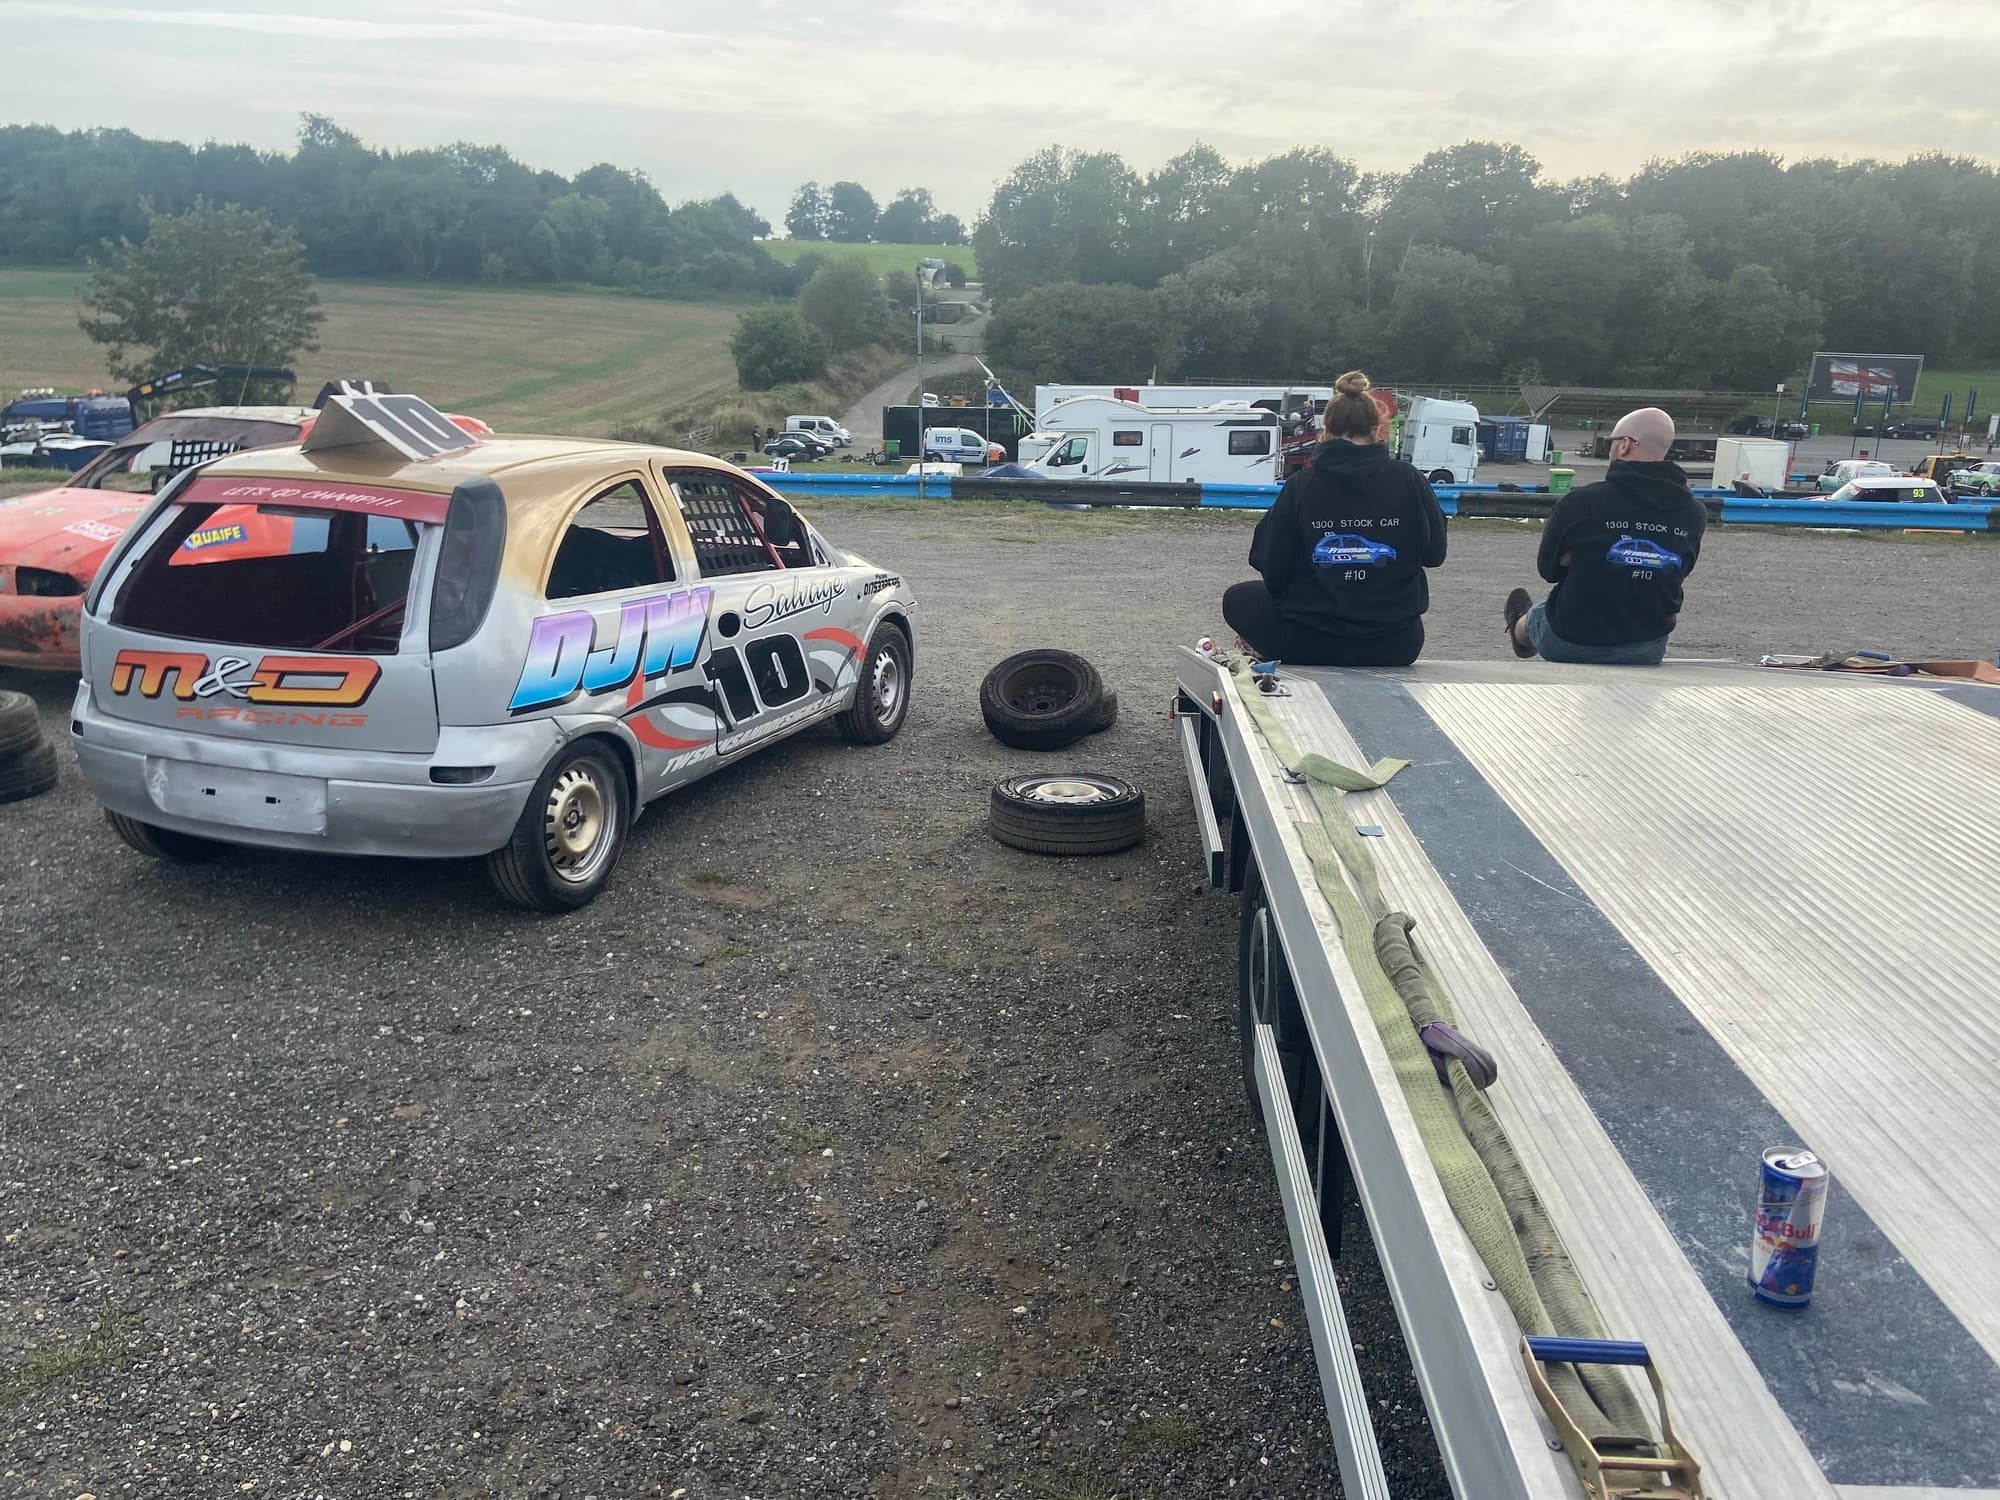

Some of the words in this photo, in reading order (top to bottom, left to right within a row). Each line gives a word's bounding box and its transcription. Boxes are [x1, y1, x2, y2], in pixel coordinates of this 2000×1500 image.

[935, 434, 953, 444] ims
[773, 459, 787, 472] 11
[222, 486, 271, 497] LETS
[271, 488, 301, 499] GO
[1913, 488, 1925, 497] 93
[1311, 520, 1334, 529] 1300
[1340, 519, 1373, 528] STOCK
[1380, 518, 1400, 527] CAR
[1606, 521, 1629, 529] 1300
[1635, 522, 1668, 533] STOCK
[1674, 527, 1688, 537] CAR
[191, 525, 241, 546] QUAIFE
[1344, 569, 1366, 580] #10
[1632, 570, 1653, 580] #10
[743, 576, 846, 629] Salvage
[507, 586, 716, 717] DJW
[110, 648, 382, 708] M&D
[700, 633, 813, 723] 10
[175, 706, 369, 727] RACING
[1781, 1222, 1815, 1239] Bull
